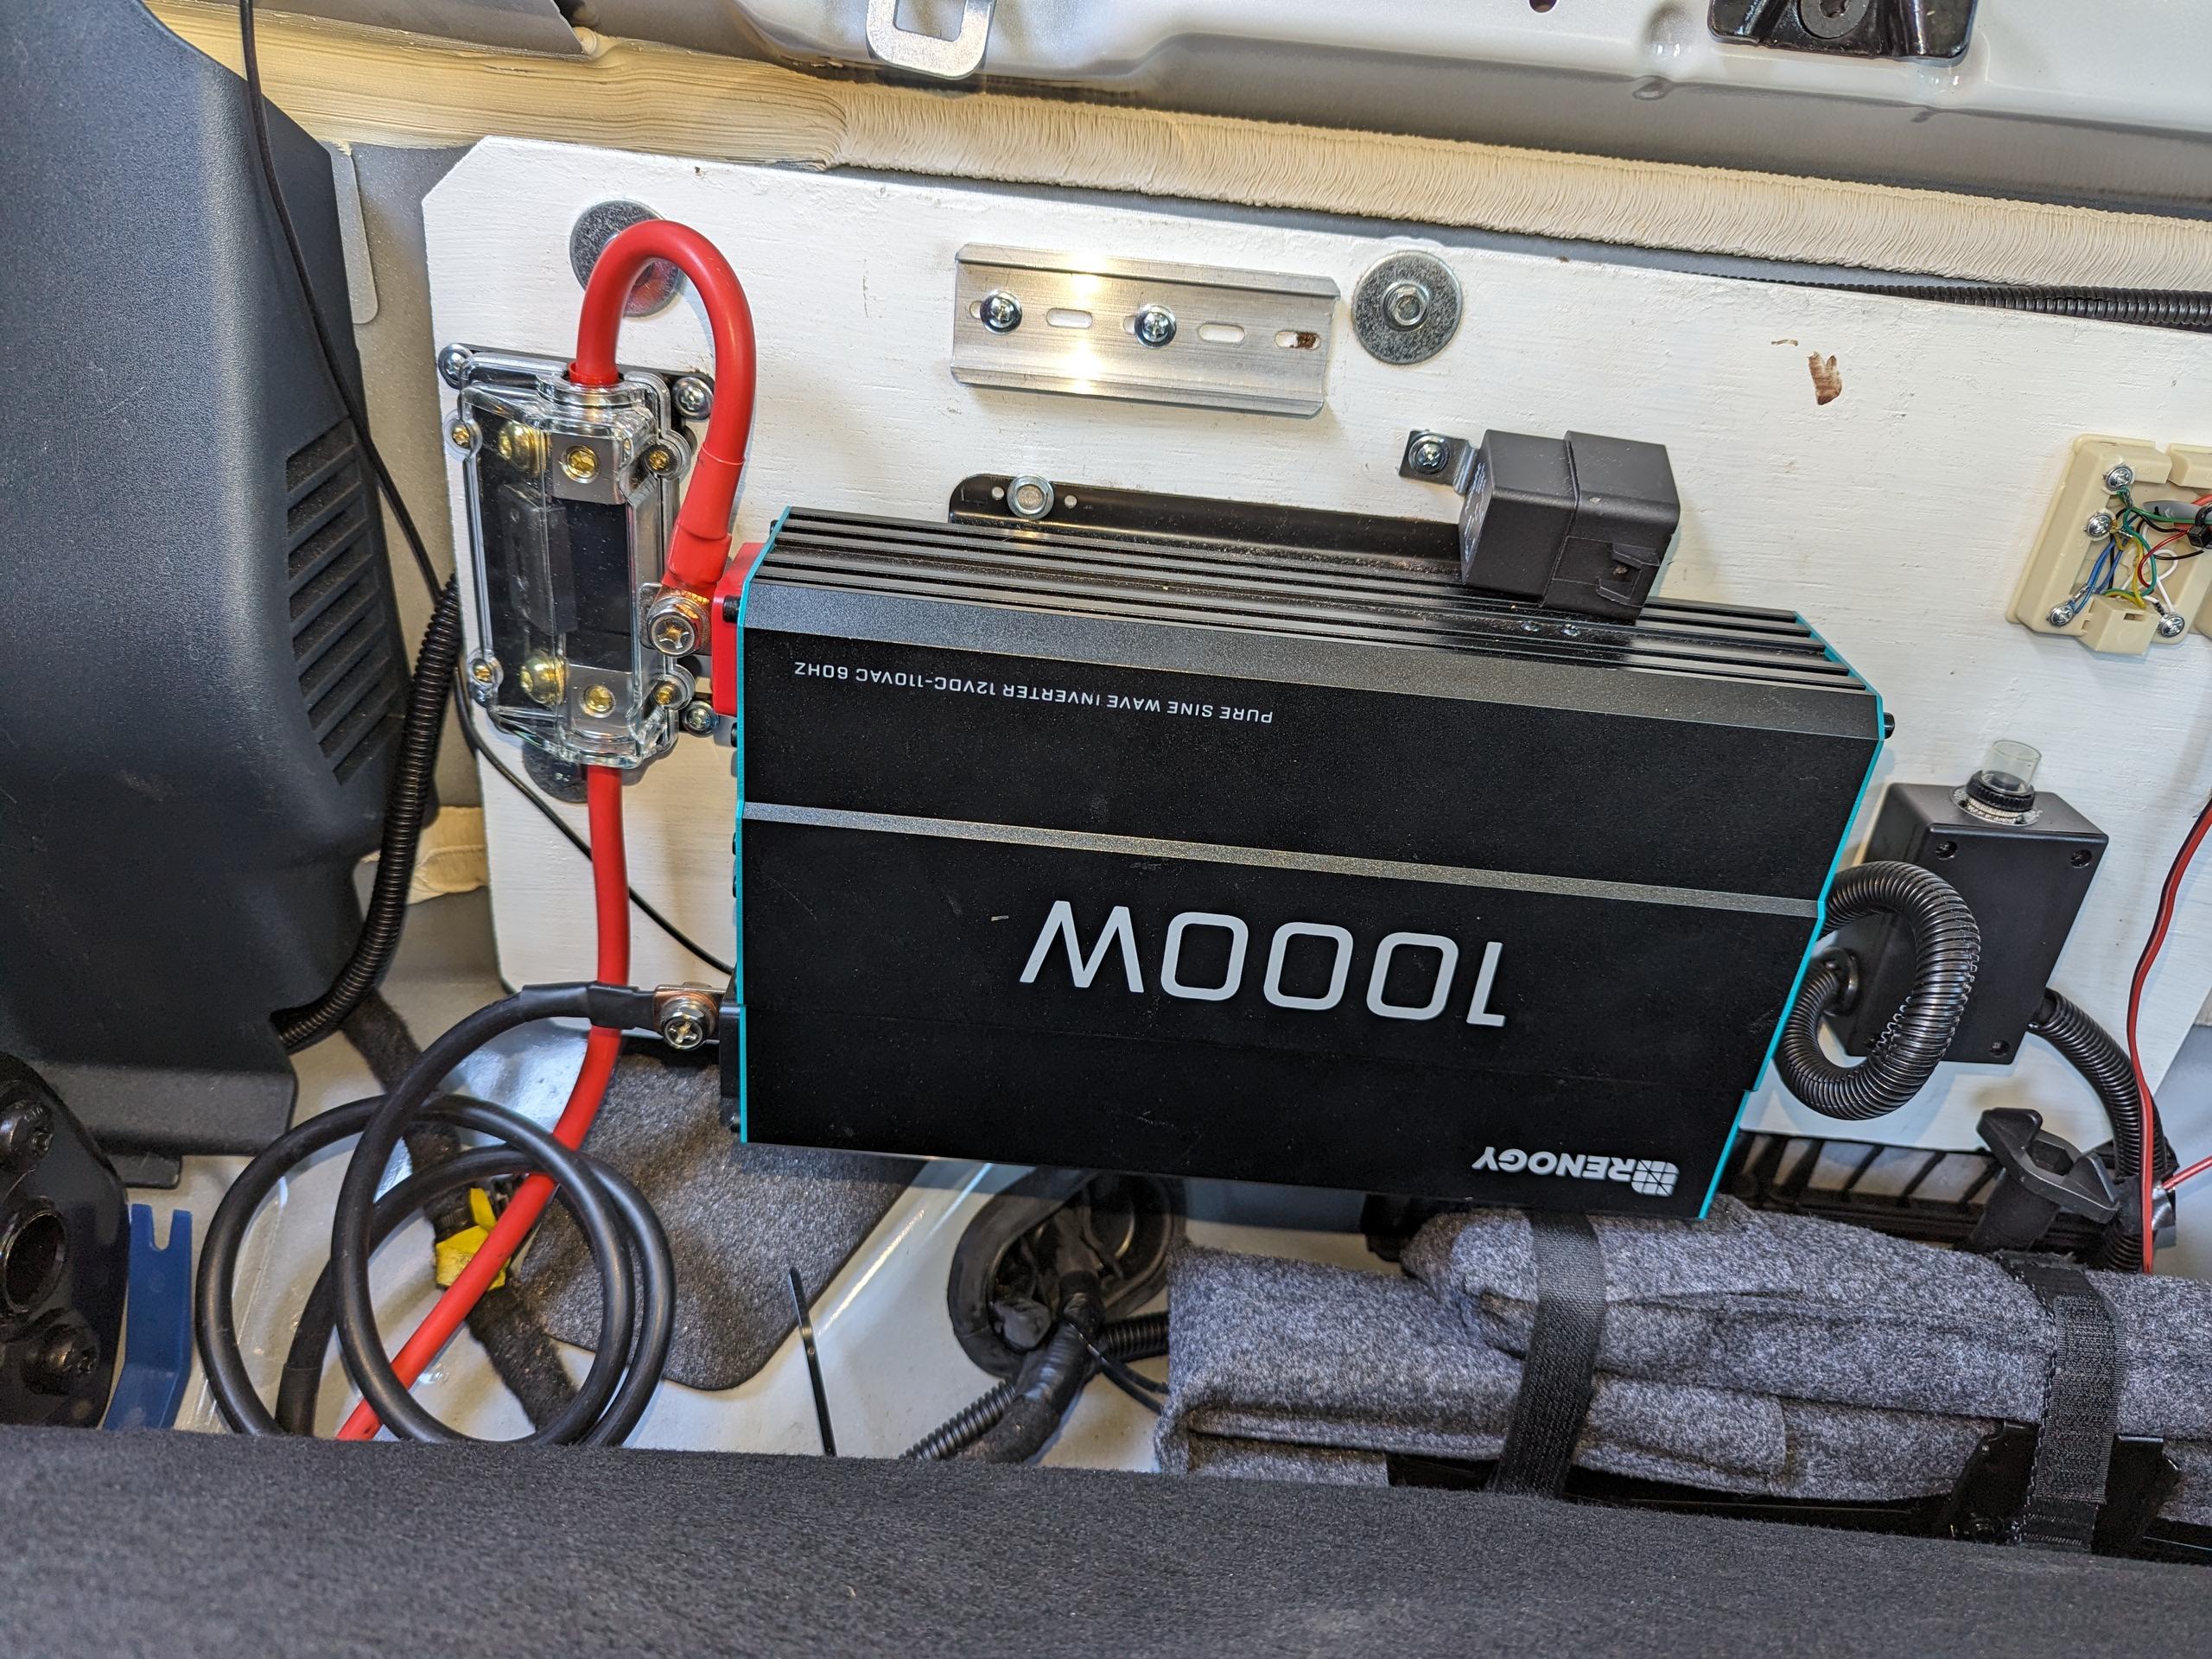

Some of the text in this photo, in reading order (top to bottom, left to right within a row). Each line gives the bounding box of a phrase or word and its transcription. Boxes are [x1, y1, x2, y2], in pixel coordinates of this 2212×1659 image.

[794, 661, 1274, 723] PURE SINE WAVE INVERTER 12VDC-110VAC 60HZ
[1020, 900, 1505, 1027] 1000W
[1471, 1146, 1637, 1183] RENOGY
